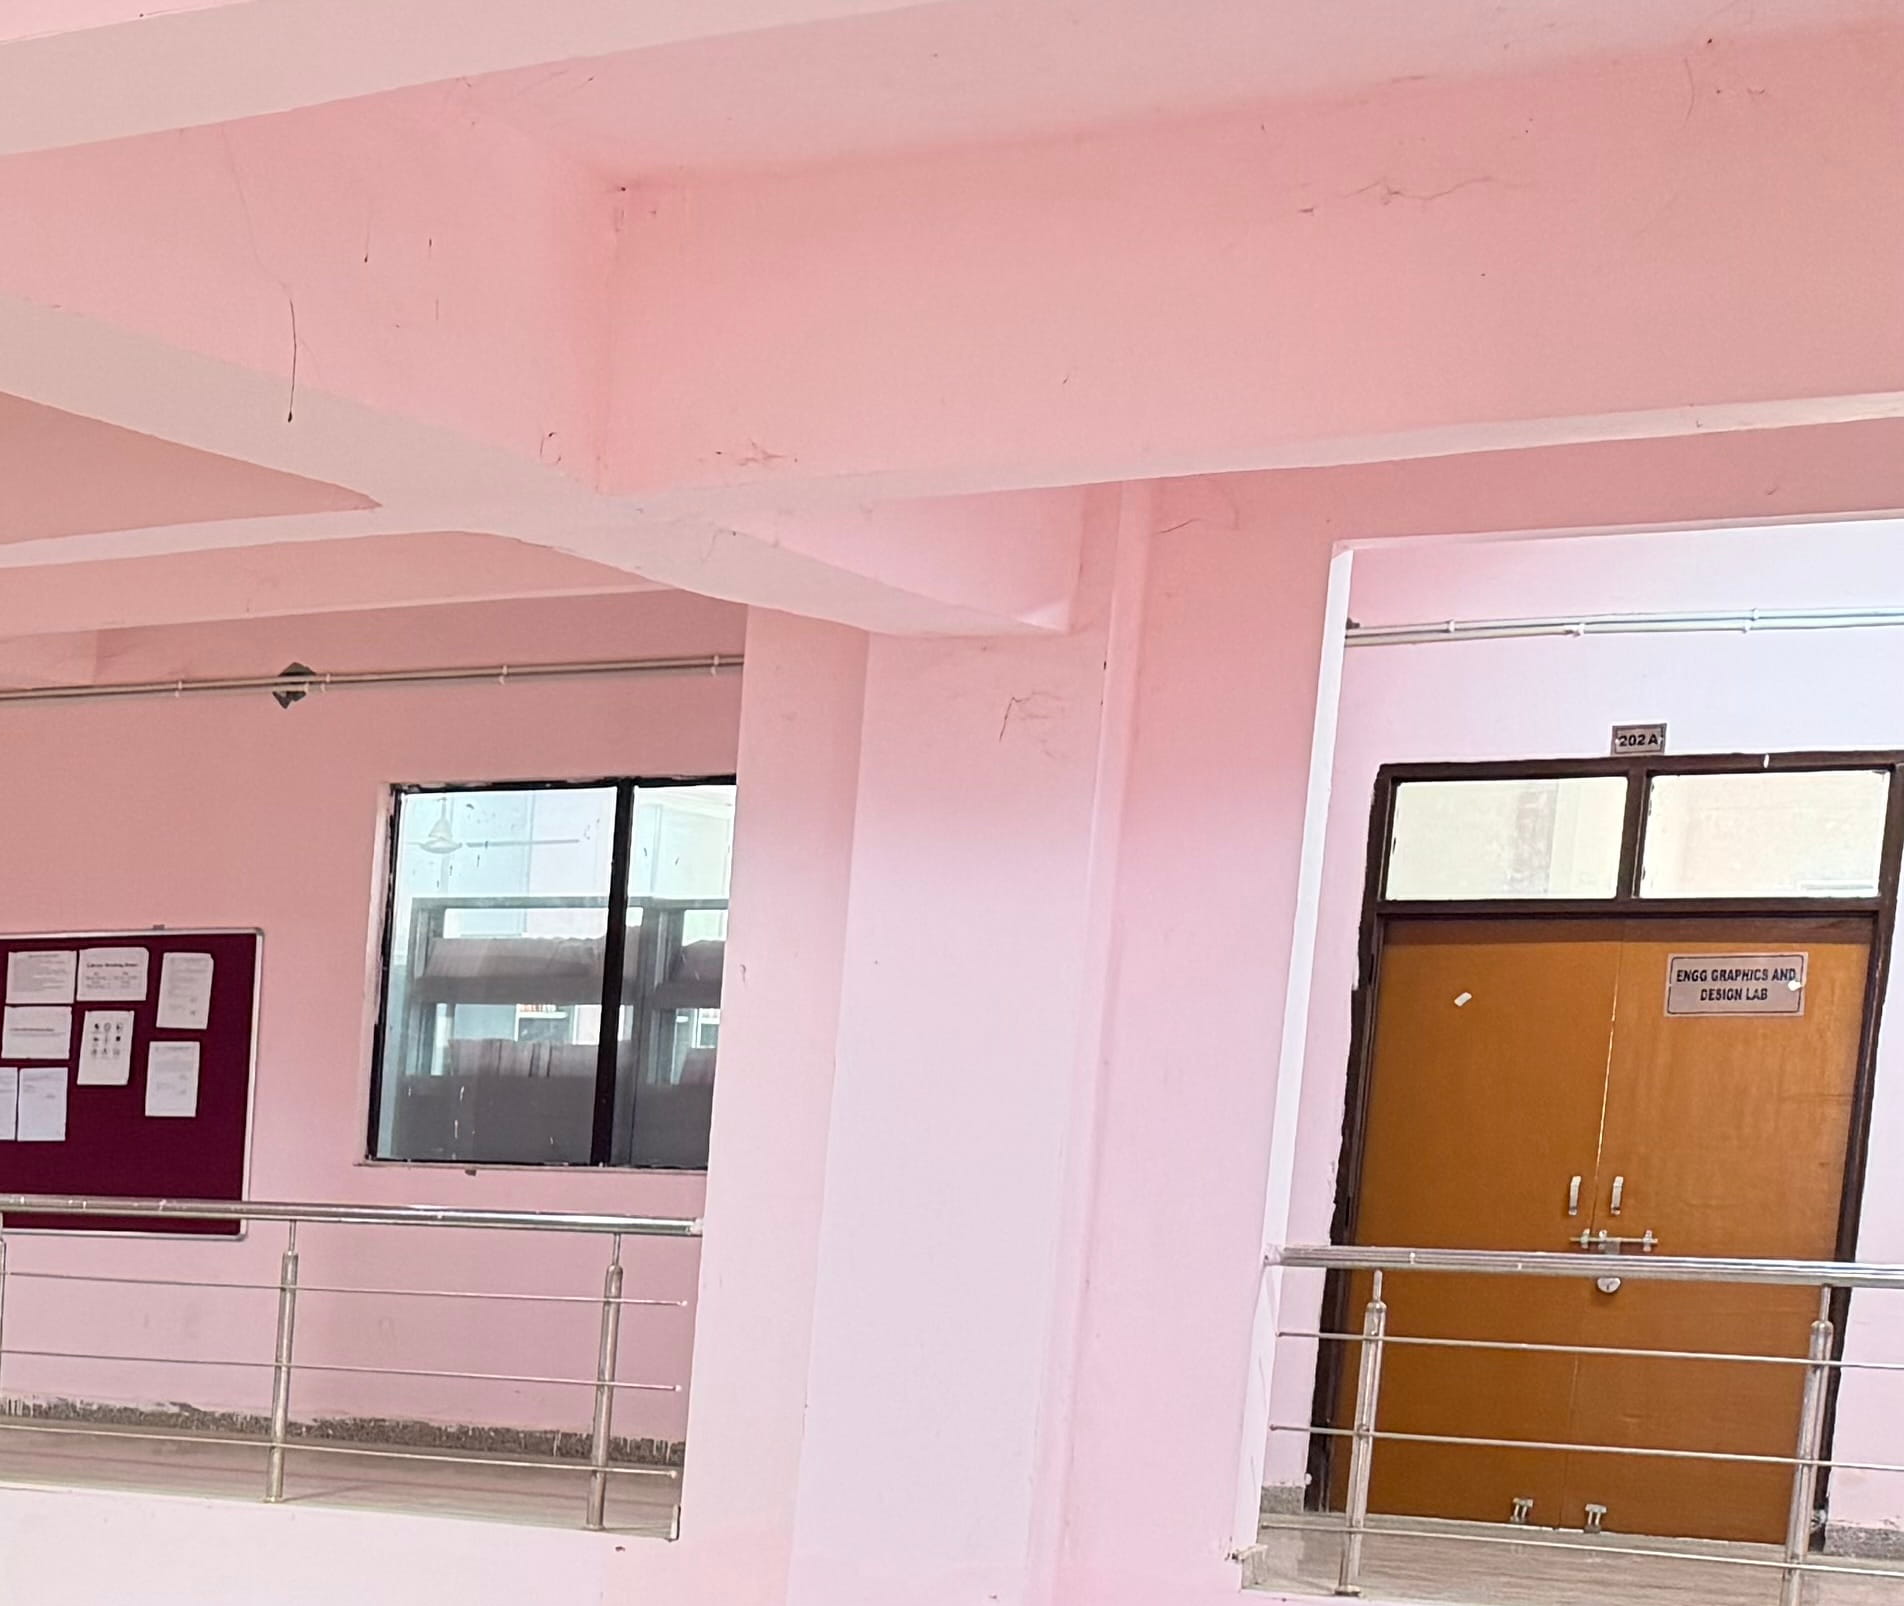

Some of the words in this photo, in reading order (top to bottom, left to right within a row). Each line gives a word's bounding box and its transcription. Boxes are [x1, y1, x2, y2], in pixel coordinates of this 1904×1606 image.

[1676, 969, 1708, 982] ENGG
[1711, 968, 1769, 981] GRAPHICS
[1772, 967, 1796, 981] AND
[1700, 988, 1742, 1001] DESIGN
[1746, 987, 1768, 1001] LAB
